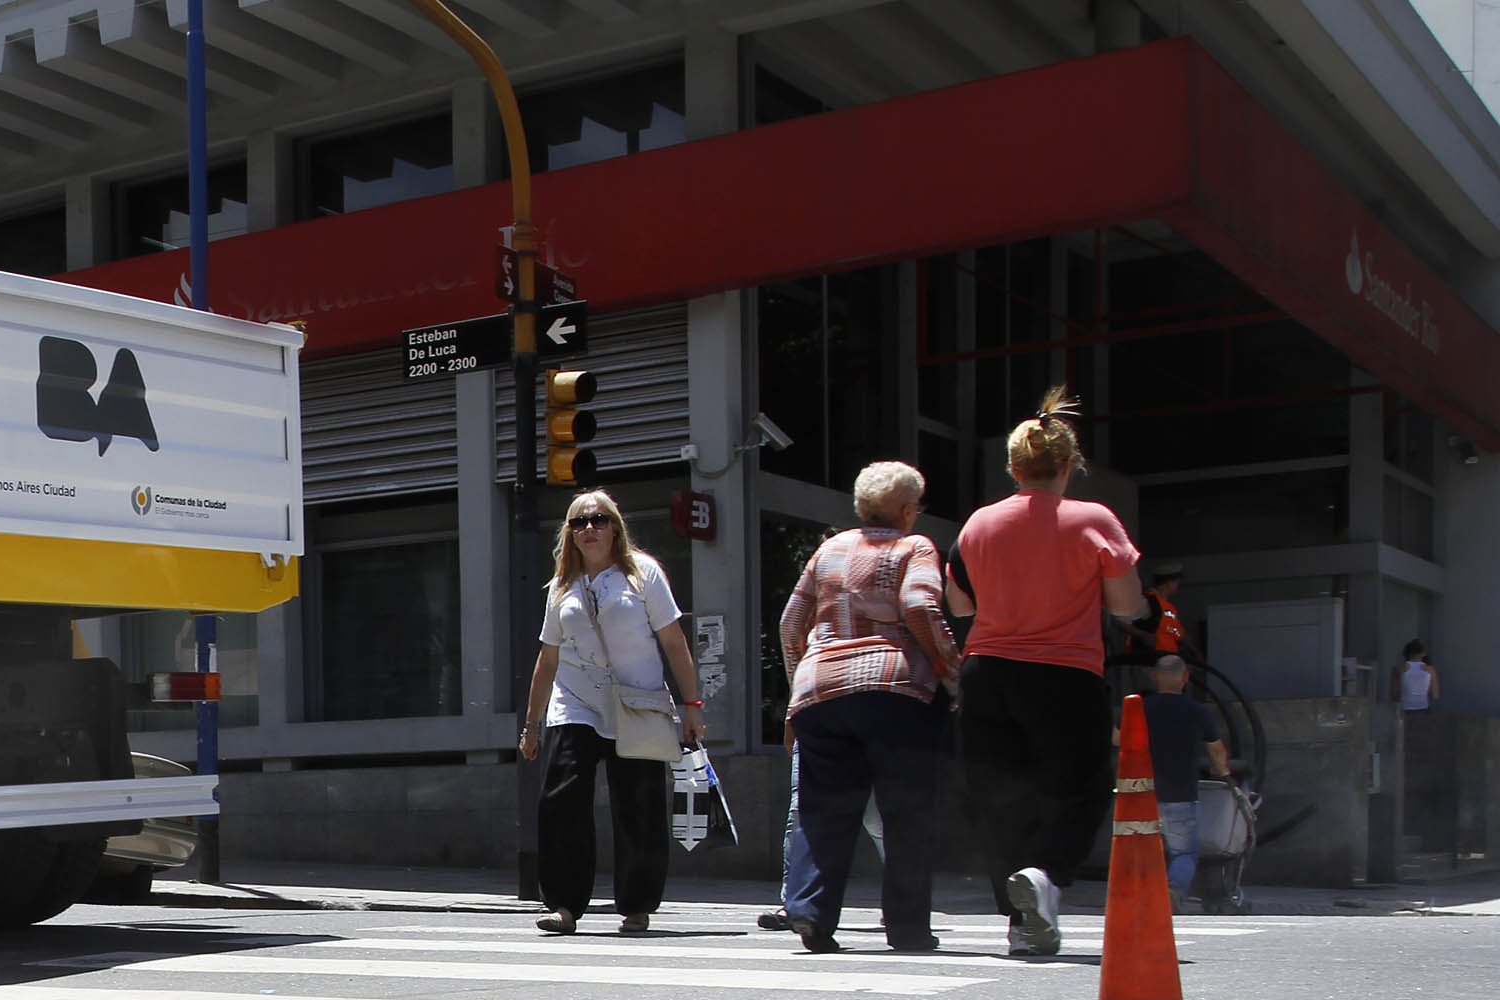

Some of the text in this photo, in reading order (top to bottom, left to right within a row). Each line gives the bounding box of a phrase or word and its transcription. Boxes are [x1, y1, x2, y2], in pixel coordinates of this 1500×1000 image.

[408, 329, 457, 345] Esteban
[408, 344, 457, 361] De Luca
[408, 362, 438, 377] 2200
[447, 355, 477, 371] 2300
[36, 335, 160, 457] BA
[16, 481, 41, 494] Aires
[43, 482, 76, 497] Ciudad
[155, 494, 227, 510] Comunas de la Ciudad
